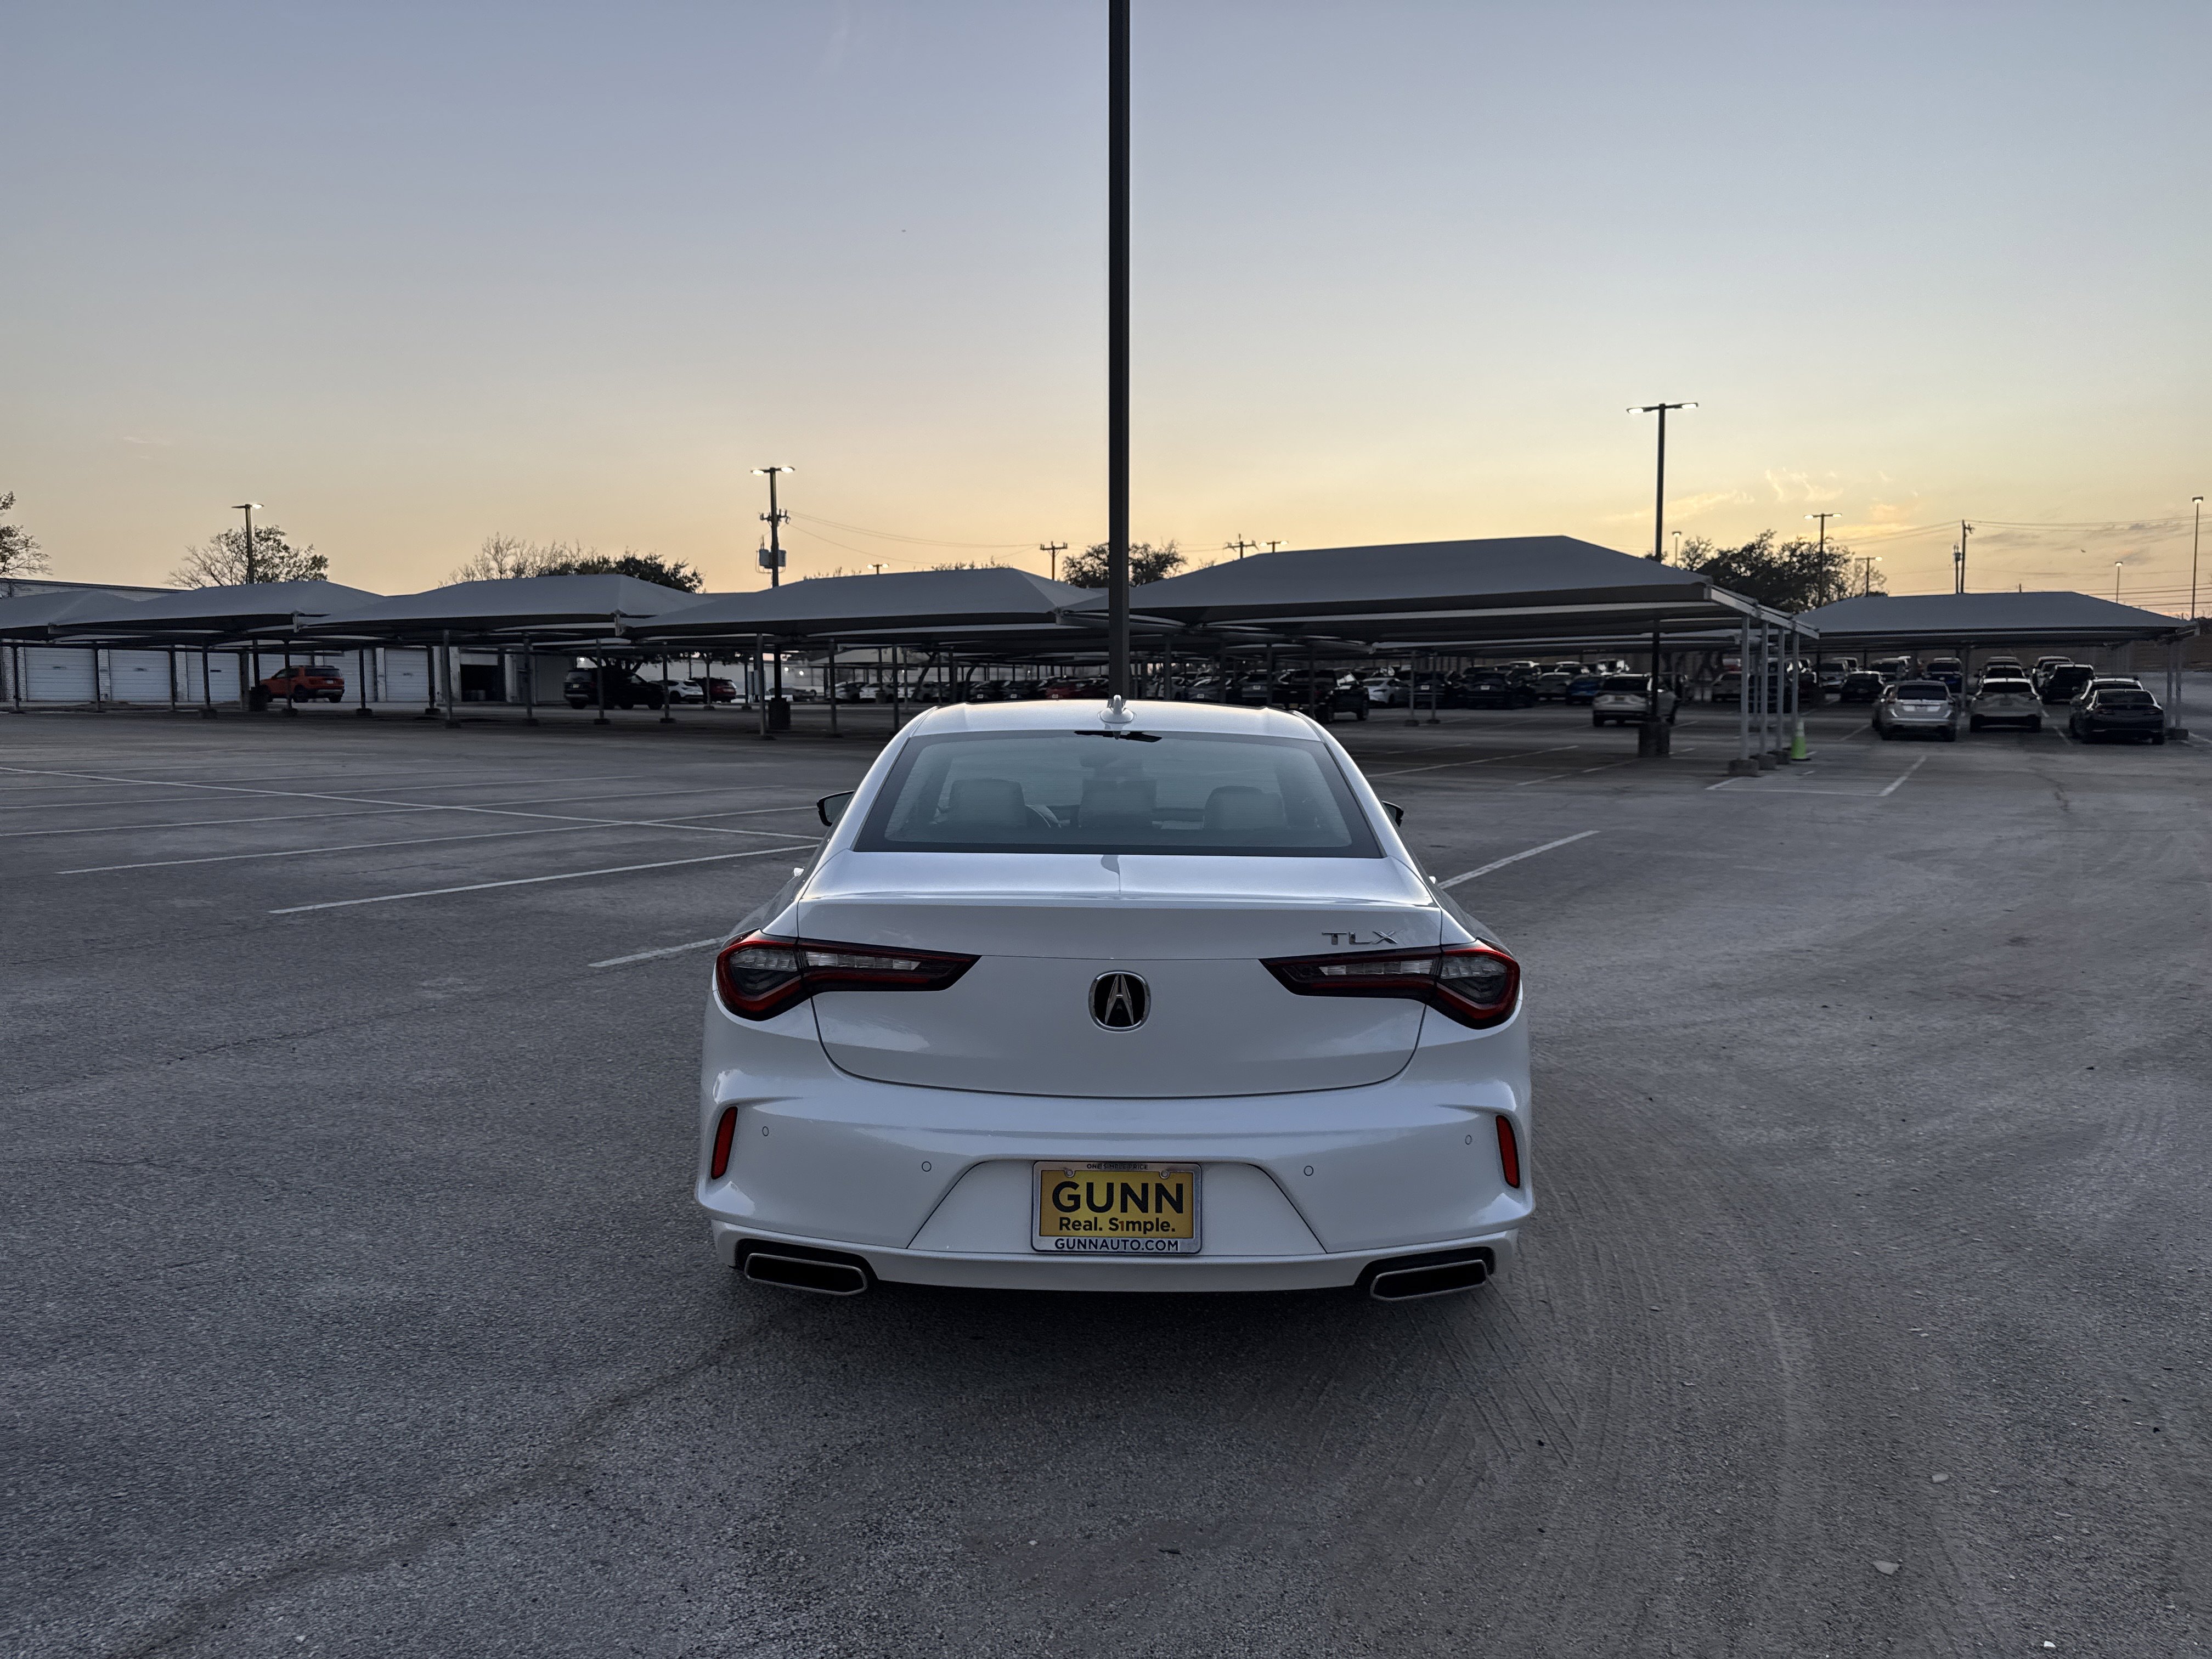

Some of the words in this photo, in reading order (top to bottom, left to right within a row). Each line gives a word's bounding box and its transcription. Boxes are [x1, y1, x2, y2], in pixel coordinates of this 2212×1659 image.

[1322, 931, 1398, 945] TLX
[1052, 1181, 1183, 1213] GUNN
[1059, 1217, 1102, 1231] Real.
[1055, 1238, 1179, 1251] GUNNAUTO.COM
